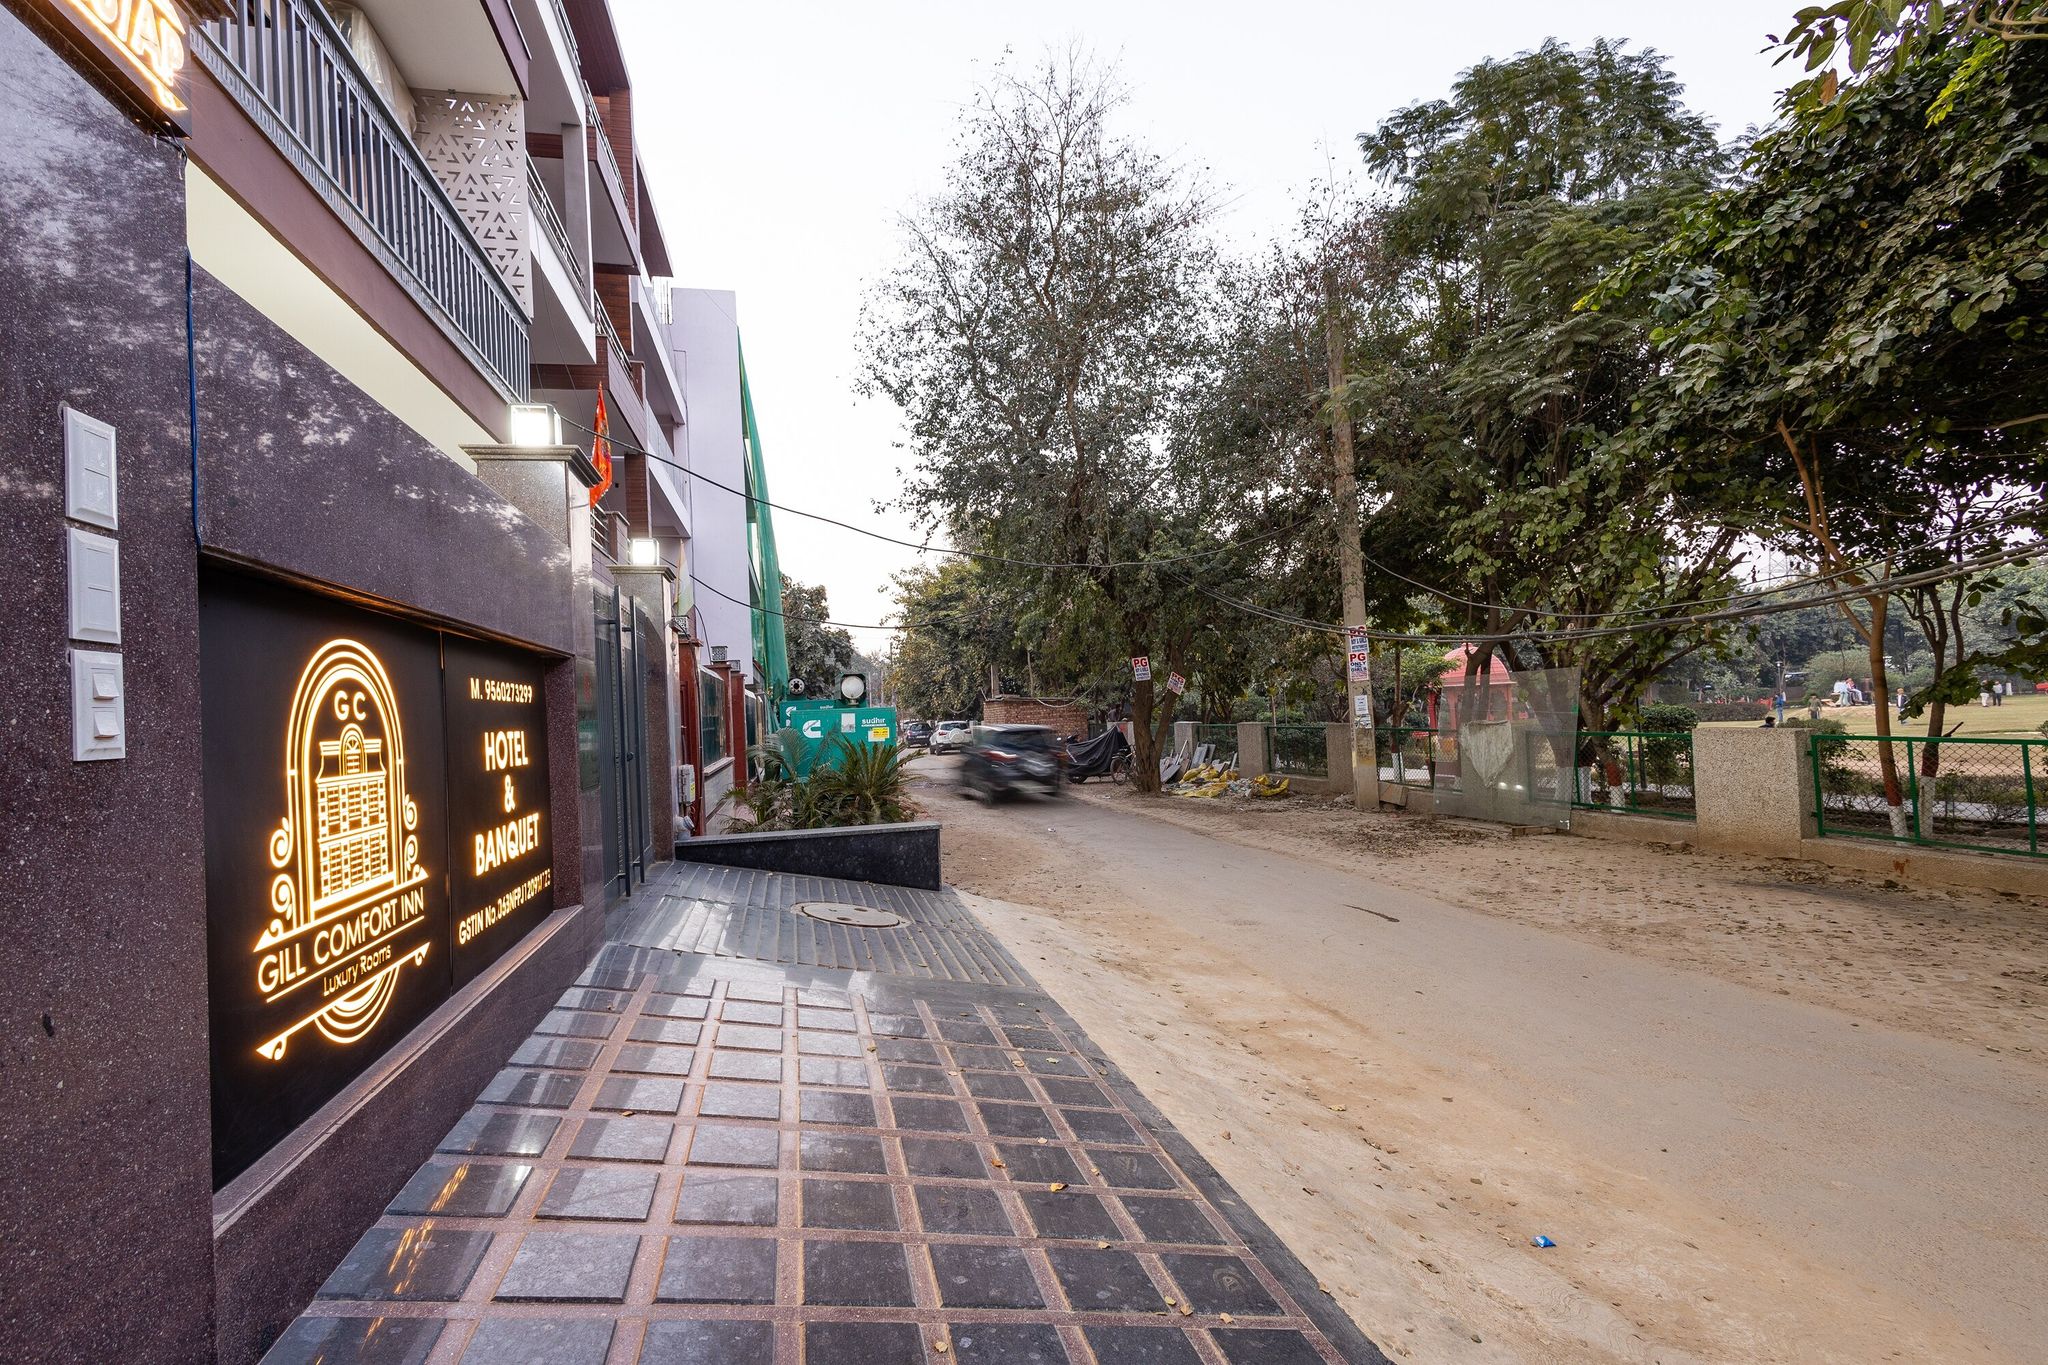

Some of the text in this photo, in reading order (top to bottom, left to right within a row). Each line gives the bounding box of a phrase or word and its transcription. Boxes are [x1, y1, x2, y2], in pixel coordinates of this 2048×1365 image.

[1133, 658, 1148, 667] PG
[1350, 653, 1366, 662] PG
[470, 677, 533, 703] M. 9560273299
[484, 731, 529, 771] HOTEL
[504, 774, 516, 813] &
[475, 812, 540, 877] BANQUET
[257, 886, 425, 993] GILL COMFORT INN
[459, 909, 484, 945] GSTIN
[323, 944, 392, 997] Luxury Rooms
